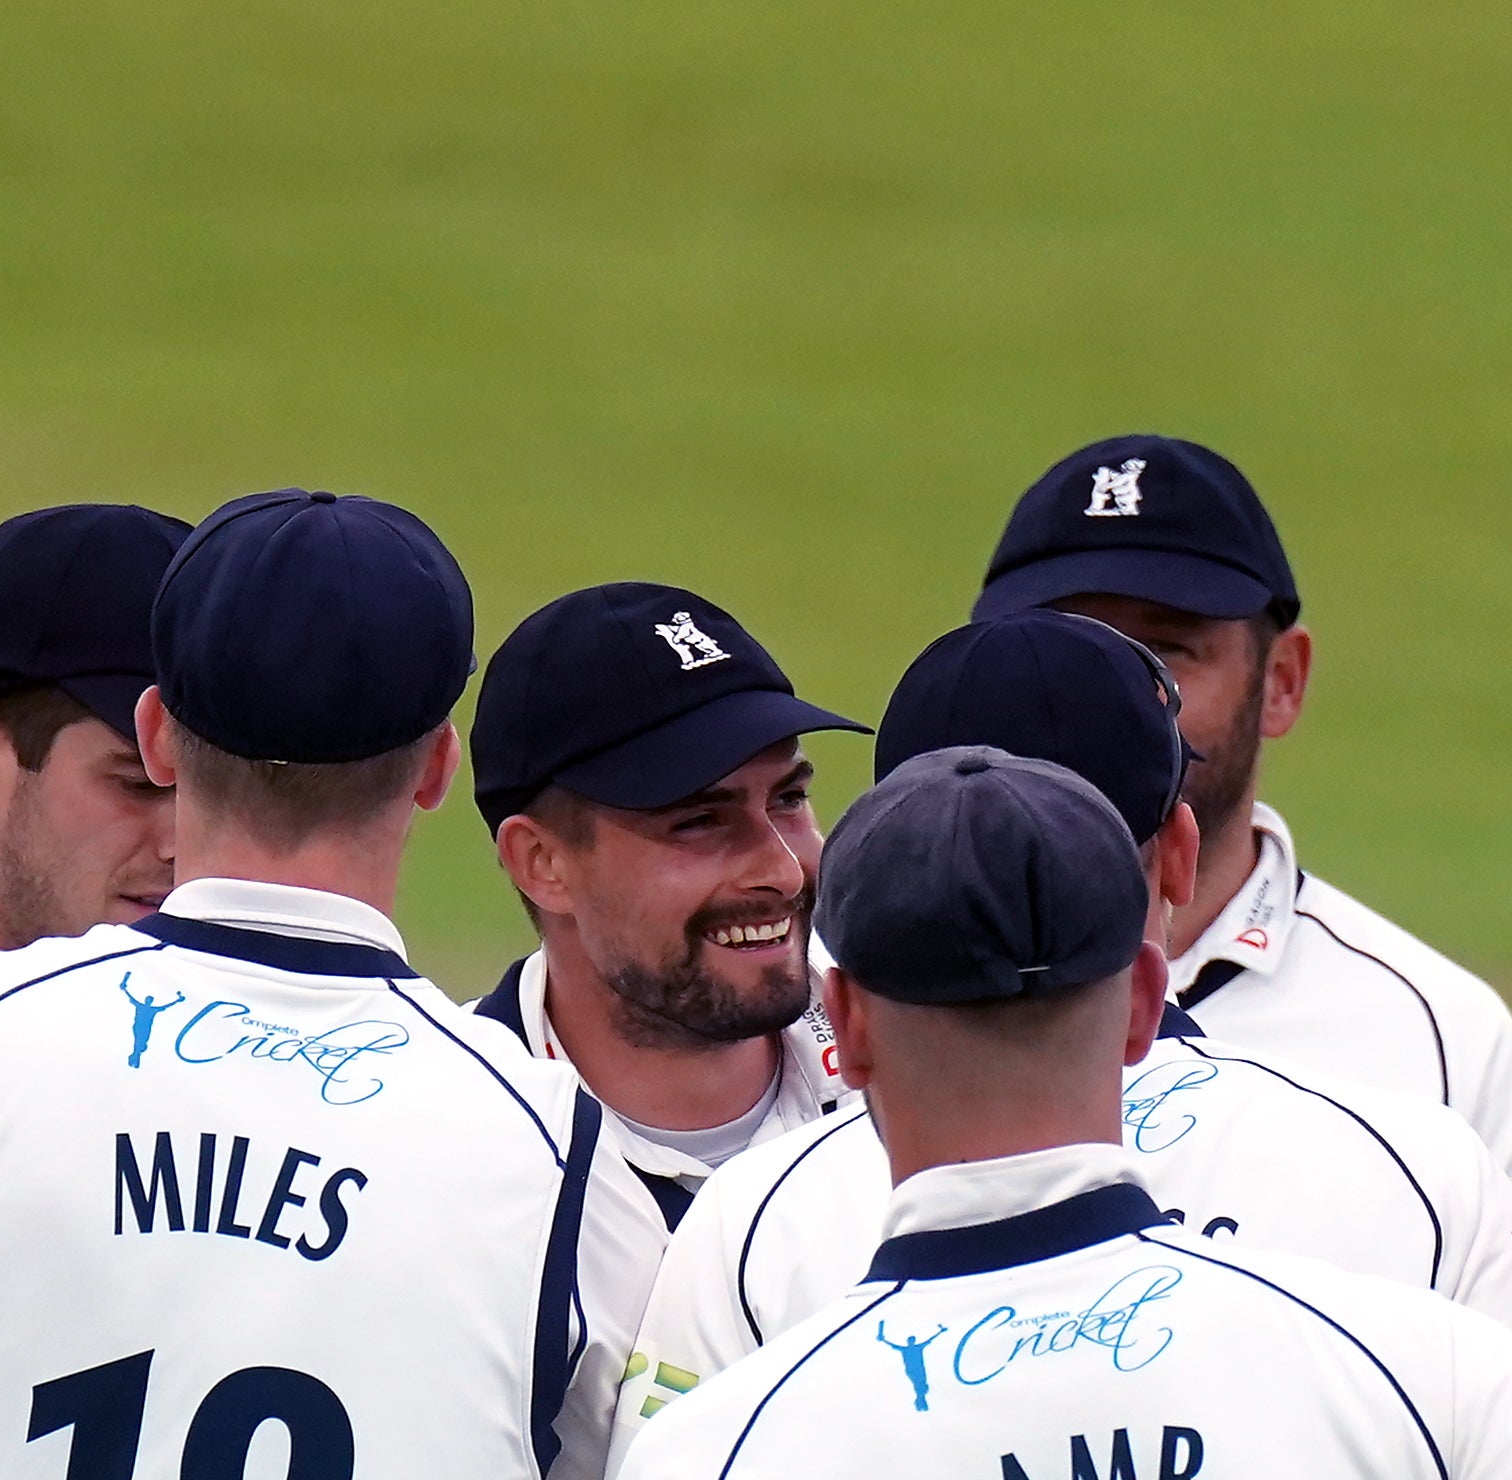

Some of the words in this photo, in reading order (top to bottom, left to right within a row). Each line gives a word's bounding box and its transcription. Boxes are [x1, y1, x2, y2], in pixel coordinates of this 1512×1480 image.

[174, 1000, 410, 1105] Cricket
[114, 1131, 369, 1262] MILES
[953, 1265, 1183, 1385] Cricket
